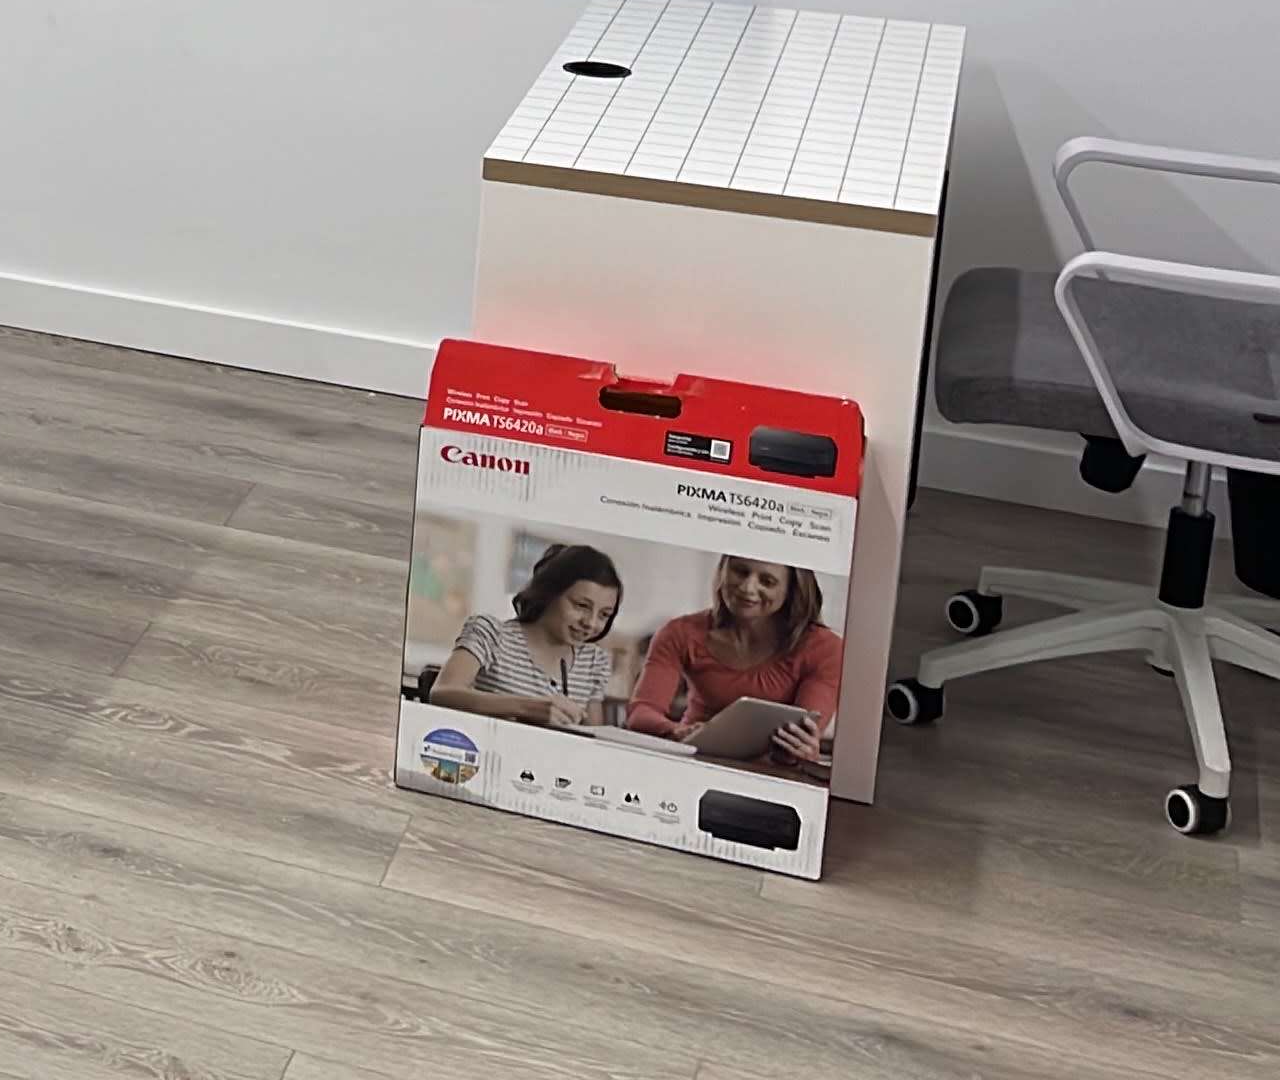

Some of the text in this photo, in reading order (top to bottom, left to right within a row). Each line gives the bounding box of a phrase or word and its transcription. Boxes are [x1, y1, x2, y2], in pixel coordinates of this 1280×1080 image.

[443, 407, 491, 427] PIXMA
[492, 415, 544, 436] TS6420a
[440, 445, 530, 476] Canon
[677, 484, 727, 504] PIXMA
[729, 491, 785, 513] TS6420a
